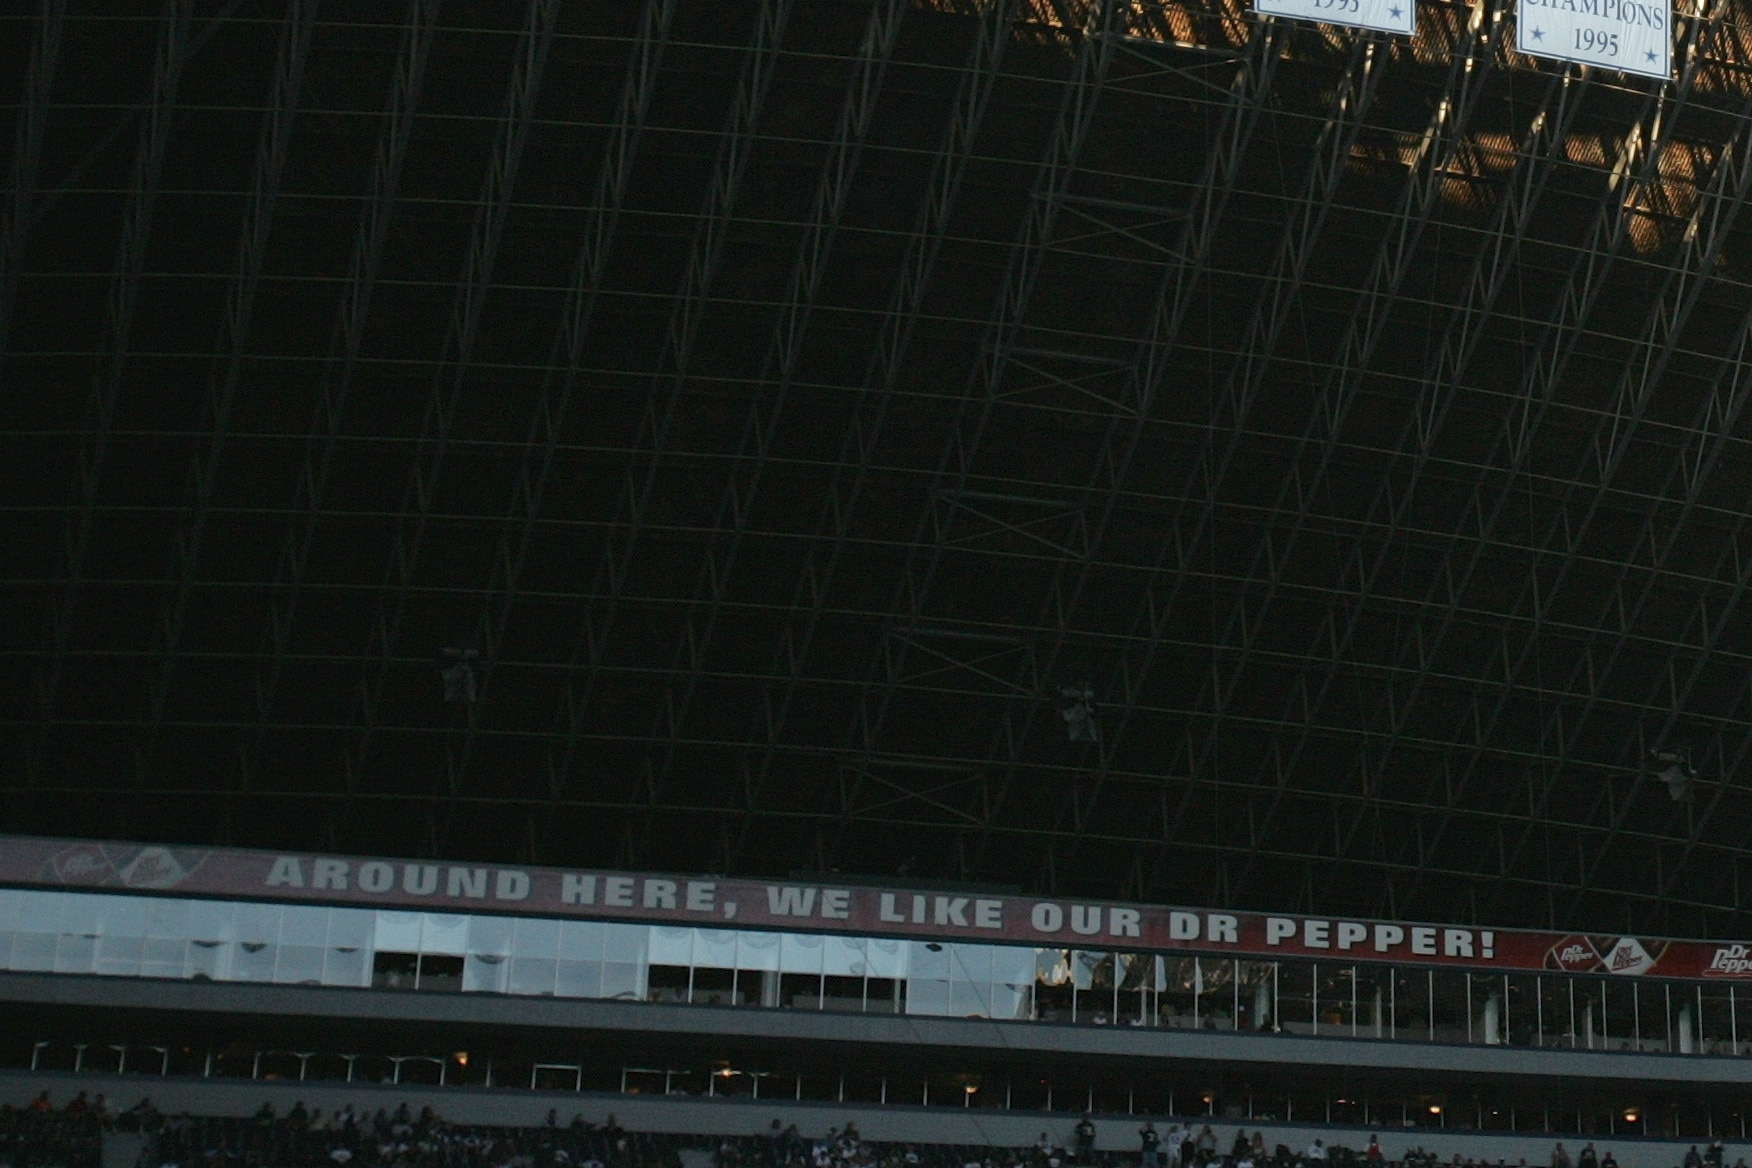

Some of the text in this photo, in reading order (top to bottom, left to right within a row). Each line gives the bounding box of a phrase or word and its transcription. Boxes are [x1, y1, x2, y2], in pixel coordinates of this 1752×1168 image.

[1573, 26, 1619, 57] 1995
[266, 856, 1496, 960] AROUND HERE, WE LIKE OUR DR PEPPER!
[1729, 944, 1750, 958] Dr
